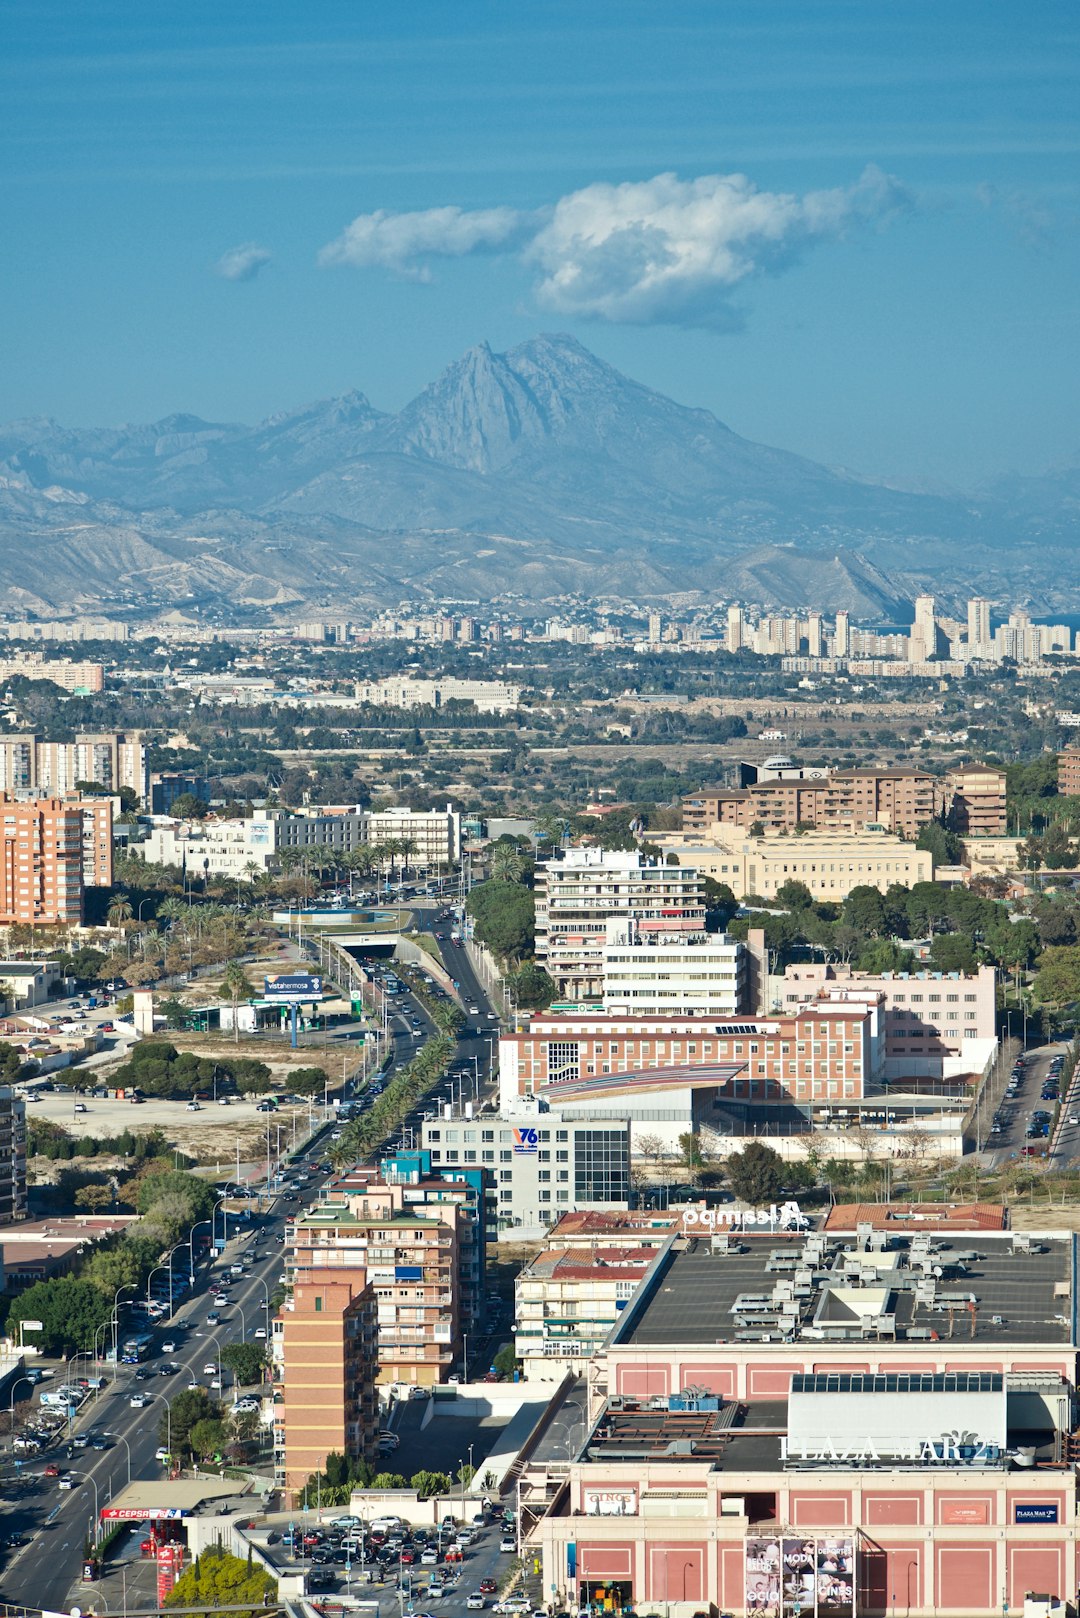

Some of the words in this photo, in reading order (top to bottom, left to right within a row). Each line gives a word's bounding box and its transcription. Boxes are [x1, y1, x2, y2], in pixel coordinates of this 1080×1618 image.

[778, 1435, 880, 1461] PLAZA
[891, 1435, 964, 1461] MAR
[974, 1436, 994, 1460] 2
[590, 1493, 631, 1502] GINOS
[783, 1553, 814, 1563] MODA
[84, 1565, 91, 1575] 5
[747, 1591, 779, 1601] OCIO
[818, 1586, 853, 1596] CINES
